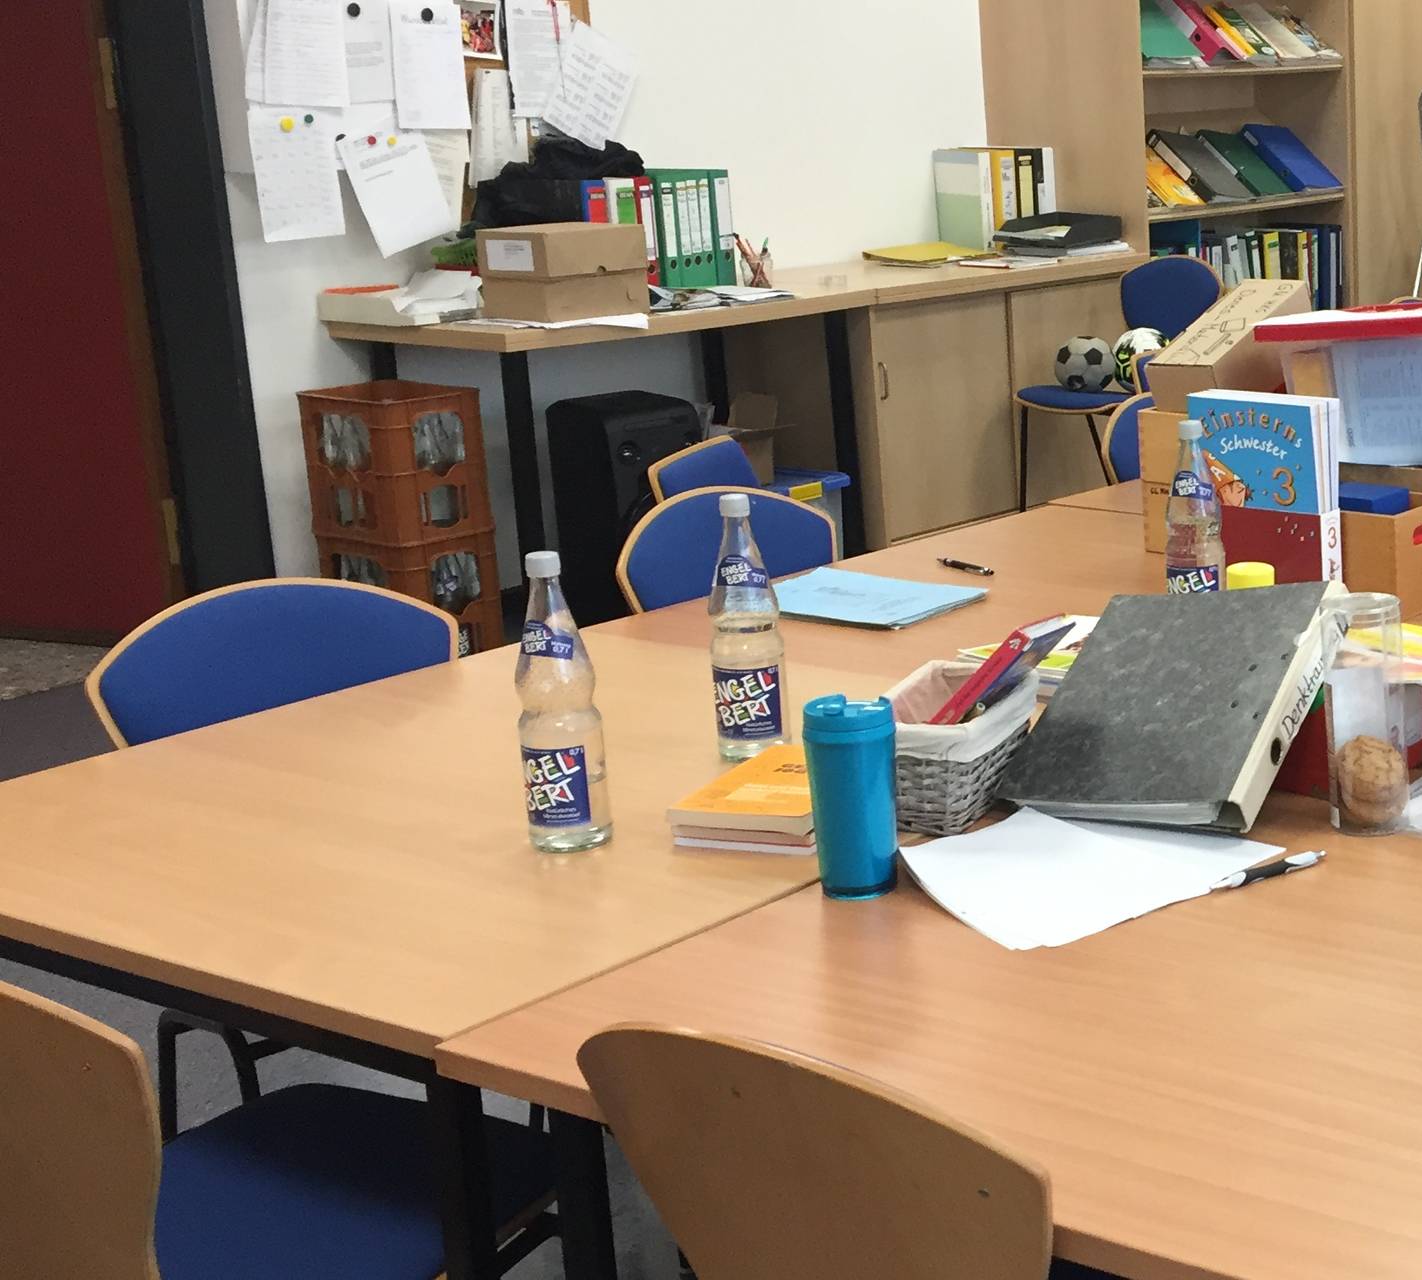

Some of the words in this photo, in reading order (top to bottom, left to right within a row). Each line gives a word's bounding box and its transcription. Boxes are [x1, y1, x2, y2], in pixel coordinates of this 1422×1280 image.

[1200, 408, 1302, 449] Einsterns
[1220, 434, 1288, 460] Schwester
[1273, 467, 1297, 507] 3
[1328, 526, 1338, 549] 3
[721, 562, 752, 577] ENGEL
[725, 573, 749, 585] BERT
[1167, 569, 1216, 595] NGEL
[522, 629, 552, 643] ENGEL
[525, 641, 547, 653] BERT
[718, 694, 771, 727] BERT
[522, 752, 581, 784] NGEL
[525, 777, 575, 812] BERT
